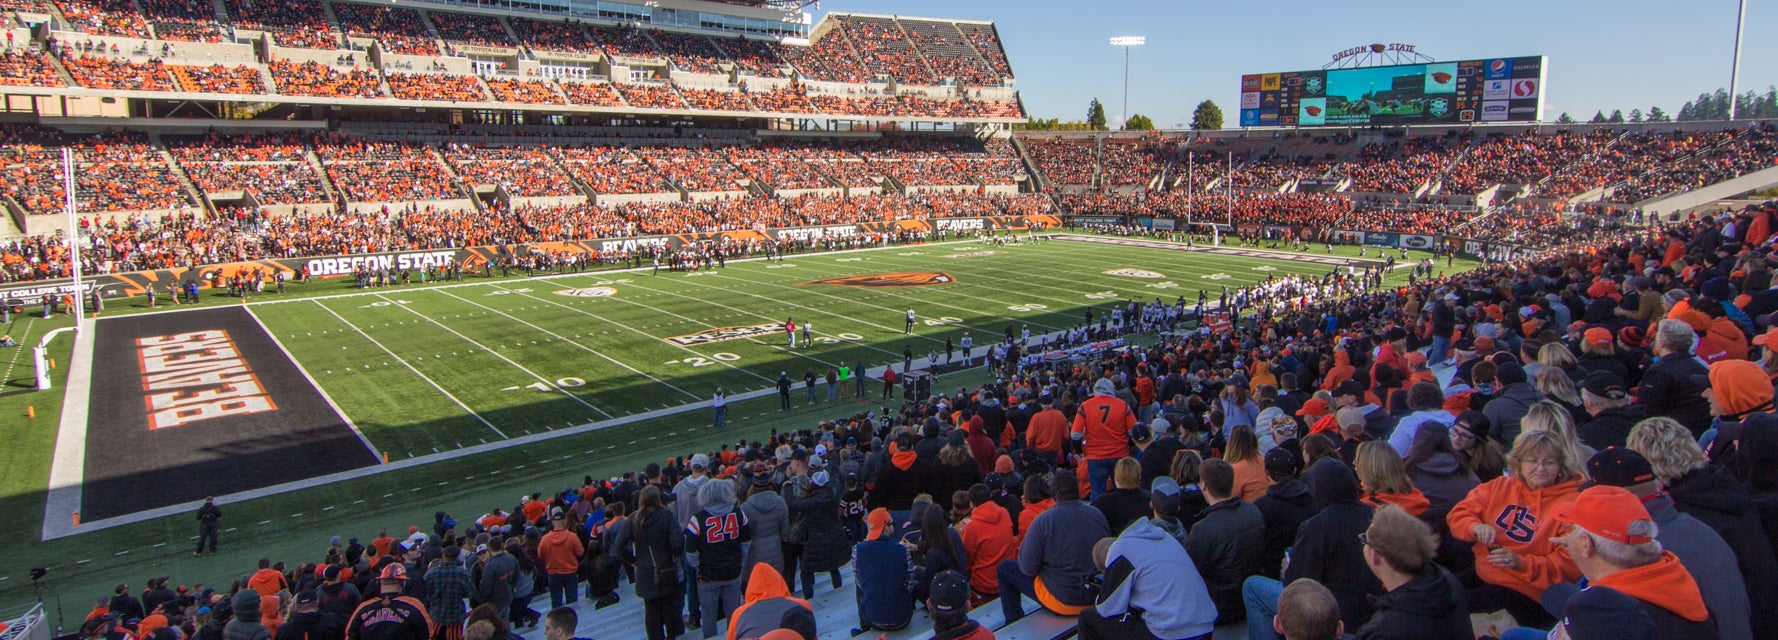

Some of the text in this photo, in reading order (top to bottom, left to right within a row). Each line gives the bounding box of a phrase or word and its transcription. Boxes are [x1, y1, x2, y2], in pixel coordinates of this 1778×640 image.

[1332, 43, 1416, 61] OREGON STATE
[936, 219, 984, 231] BEAVERS
[308, 250, 456, 276] OREGON STATE
[59, 283, 90, 293] TON
[683, 352, 741, 367] 20
[135, 328, 279, 431] BEAVERS
[525, 376, 587, 392] 10
[1098, 405, 1111, 425] 7
[849, 500, 864, 514] 24
[705, 513, 739, 544] 24
